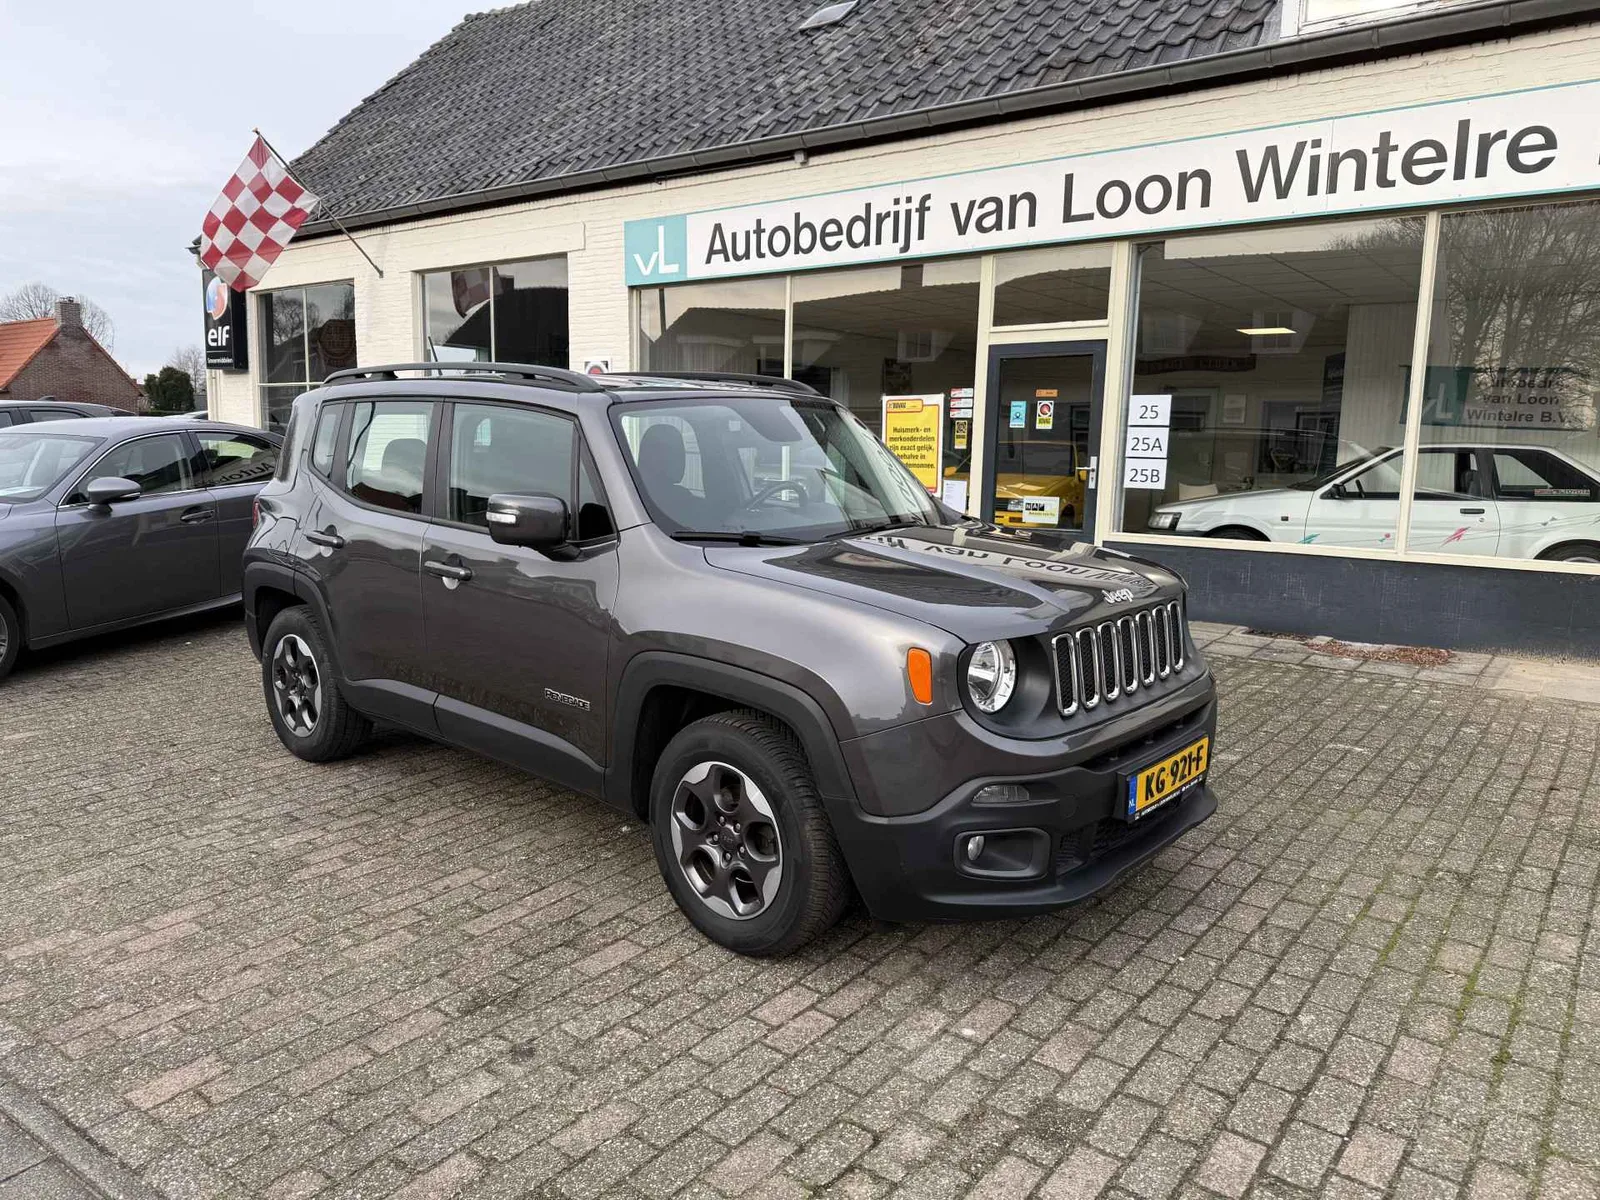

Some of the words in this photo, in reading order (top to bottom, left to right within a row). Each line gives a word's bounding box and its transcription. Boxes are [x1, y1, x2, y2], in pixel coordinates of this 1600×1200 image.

[705, 193, 932, 265] Autobedrijf
[950, 190, 1036, 237] van
[1062, 168, 1212, 224] Loon
[1235, 118, 1558, 203] Wintelre
[207, 325, 230, 347] elf
[1517, 393, 1560, 405] Loon
[1139, 405, 1159, 420] 25
[1467, 408, 1534, 422] Wintelre
[1131, 437, 1163, 452] 25A
[1129, 468, 1160, 483] 25B
[1101, 588, 1134, 604] Jeep
[544, 687, 591, 711] RENEGADE
